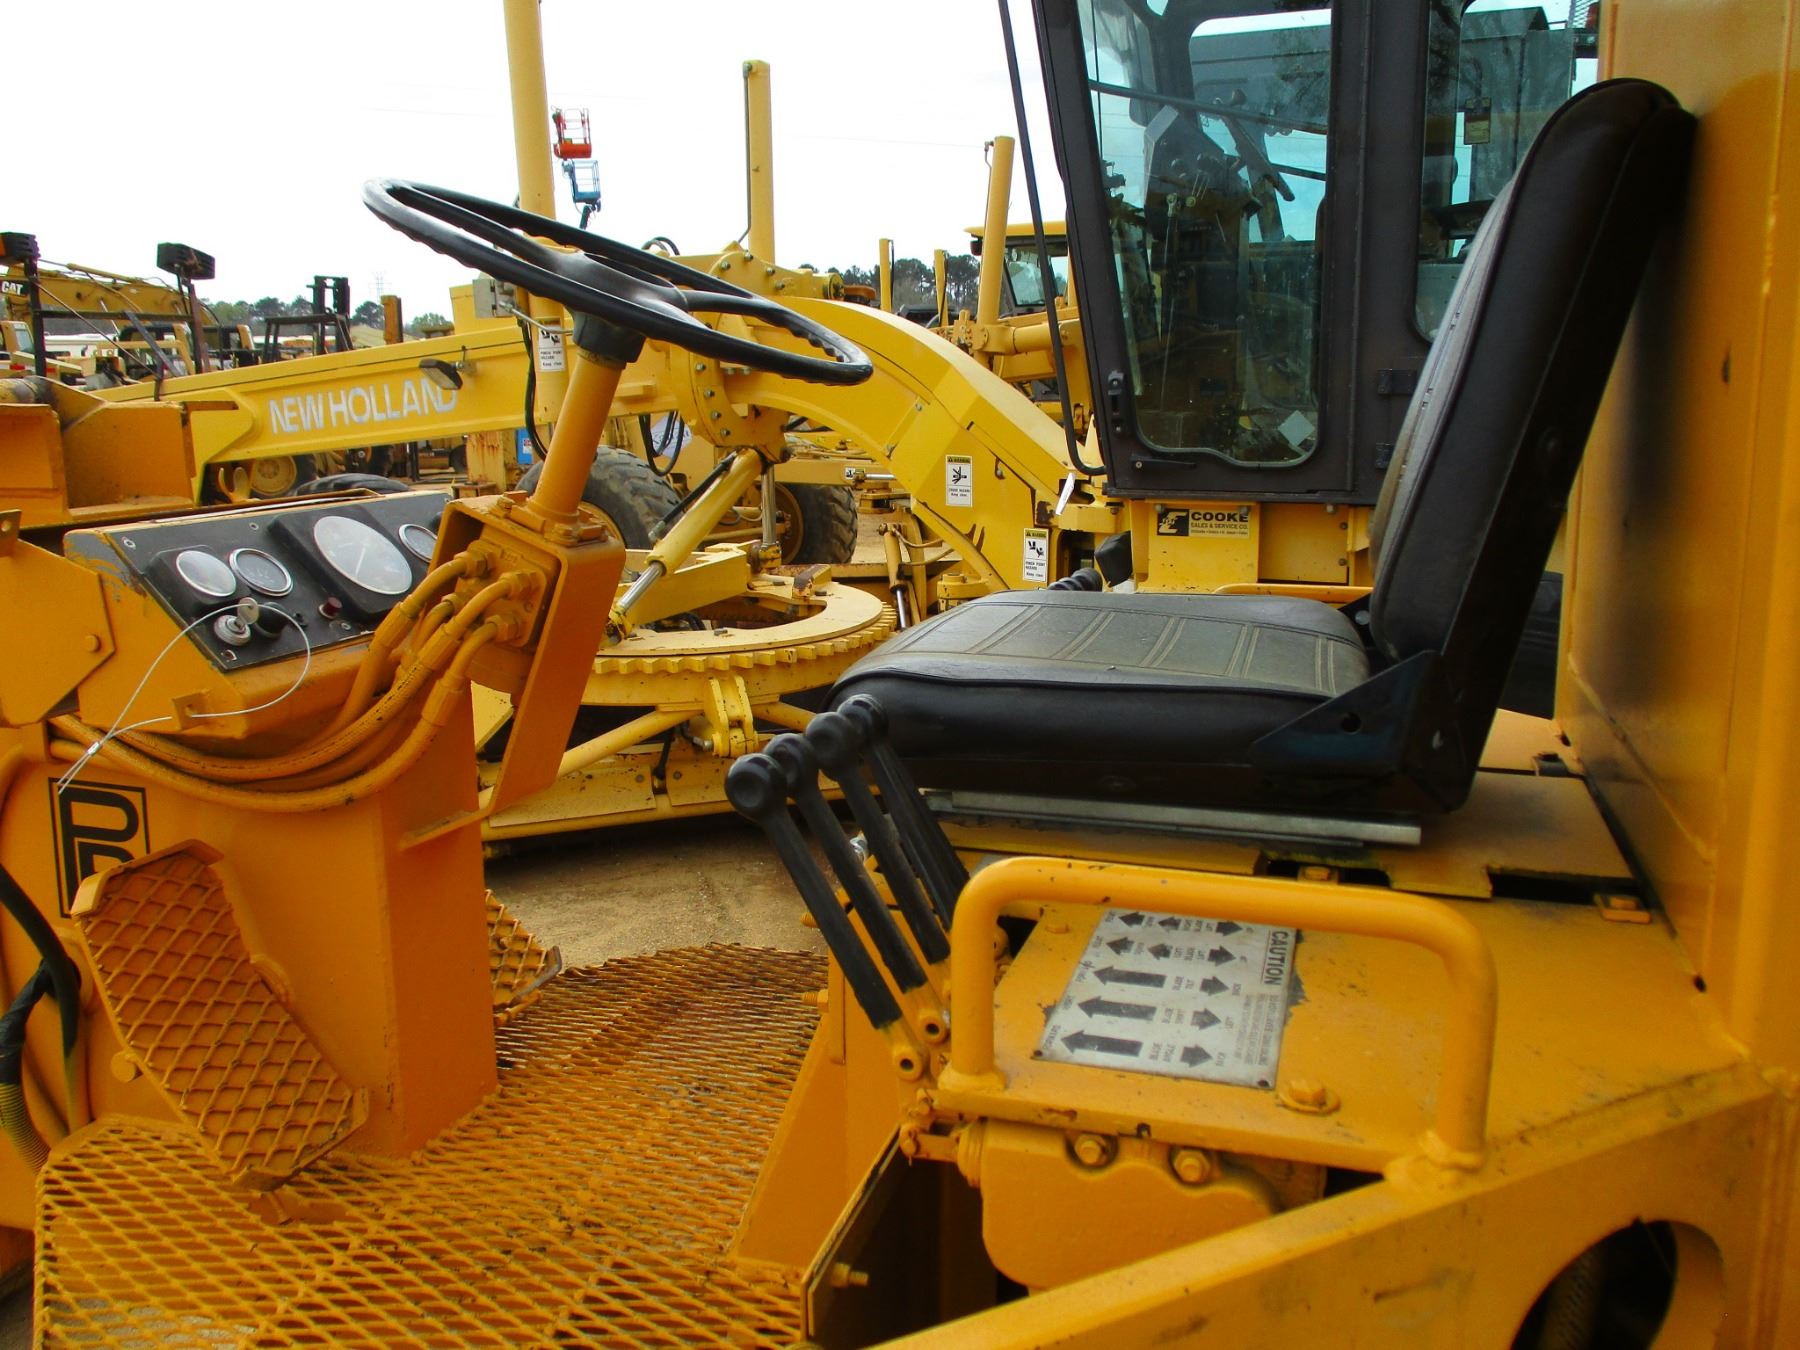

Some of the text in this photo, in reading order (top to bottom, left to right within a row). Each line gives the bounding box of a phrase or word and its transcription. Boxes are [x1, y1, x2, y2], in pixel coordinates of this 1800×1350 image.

[2, 281, 23, 295] CAT
[269, 378, 458, 434] NEW HOLLAND
[1191, 512, 1248, 522] COOKE
[1262, 930, 1289, 985] CAUTION
